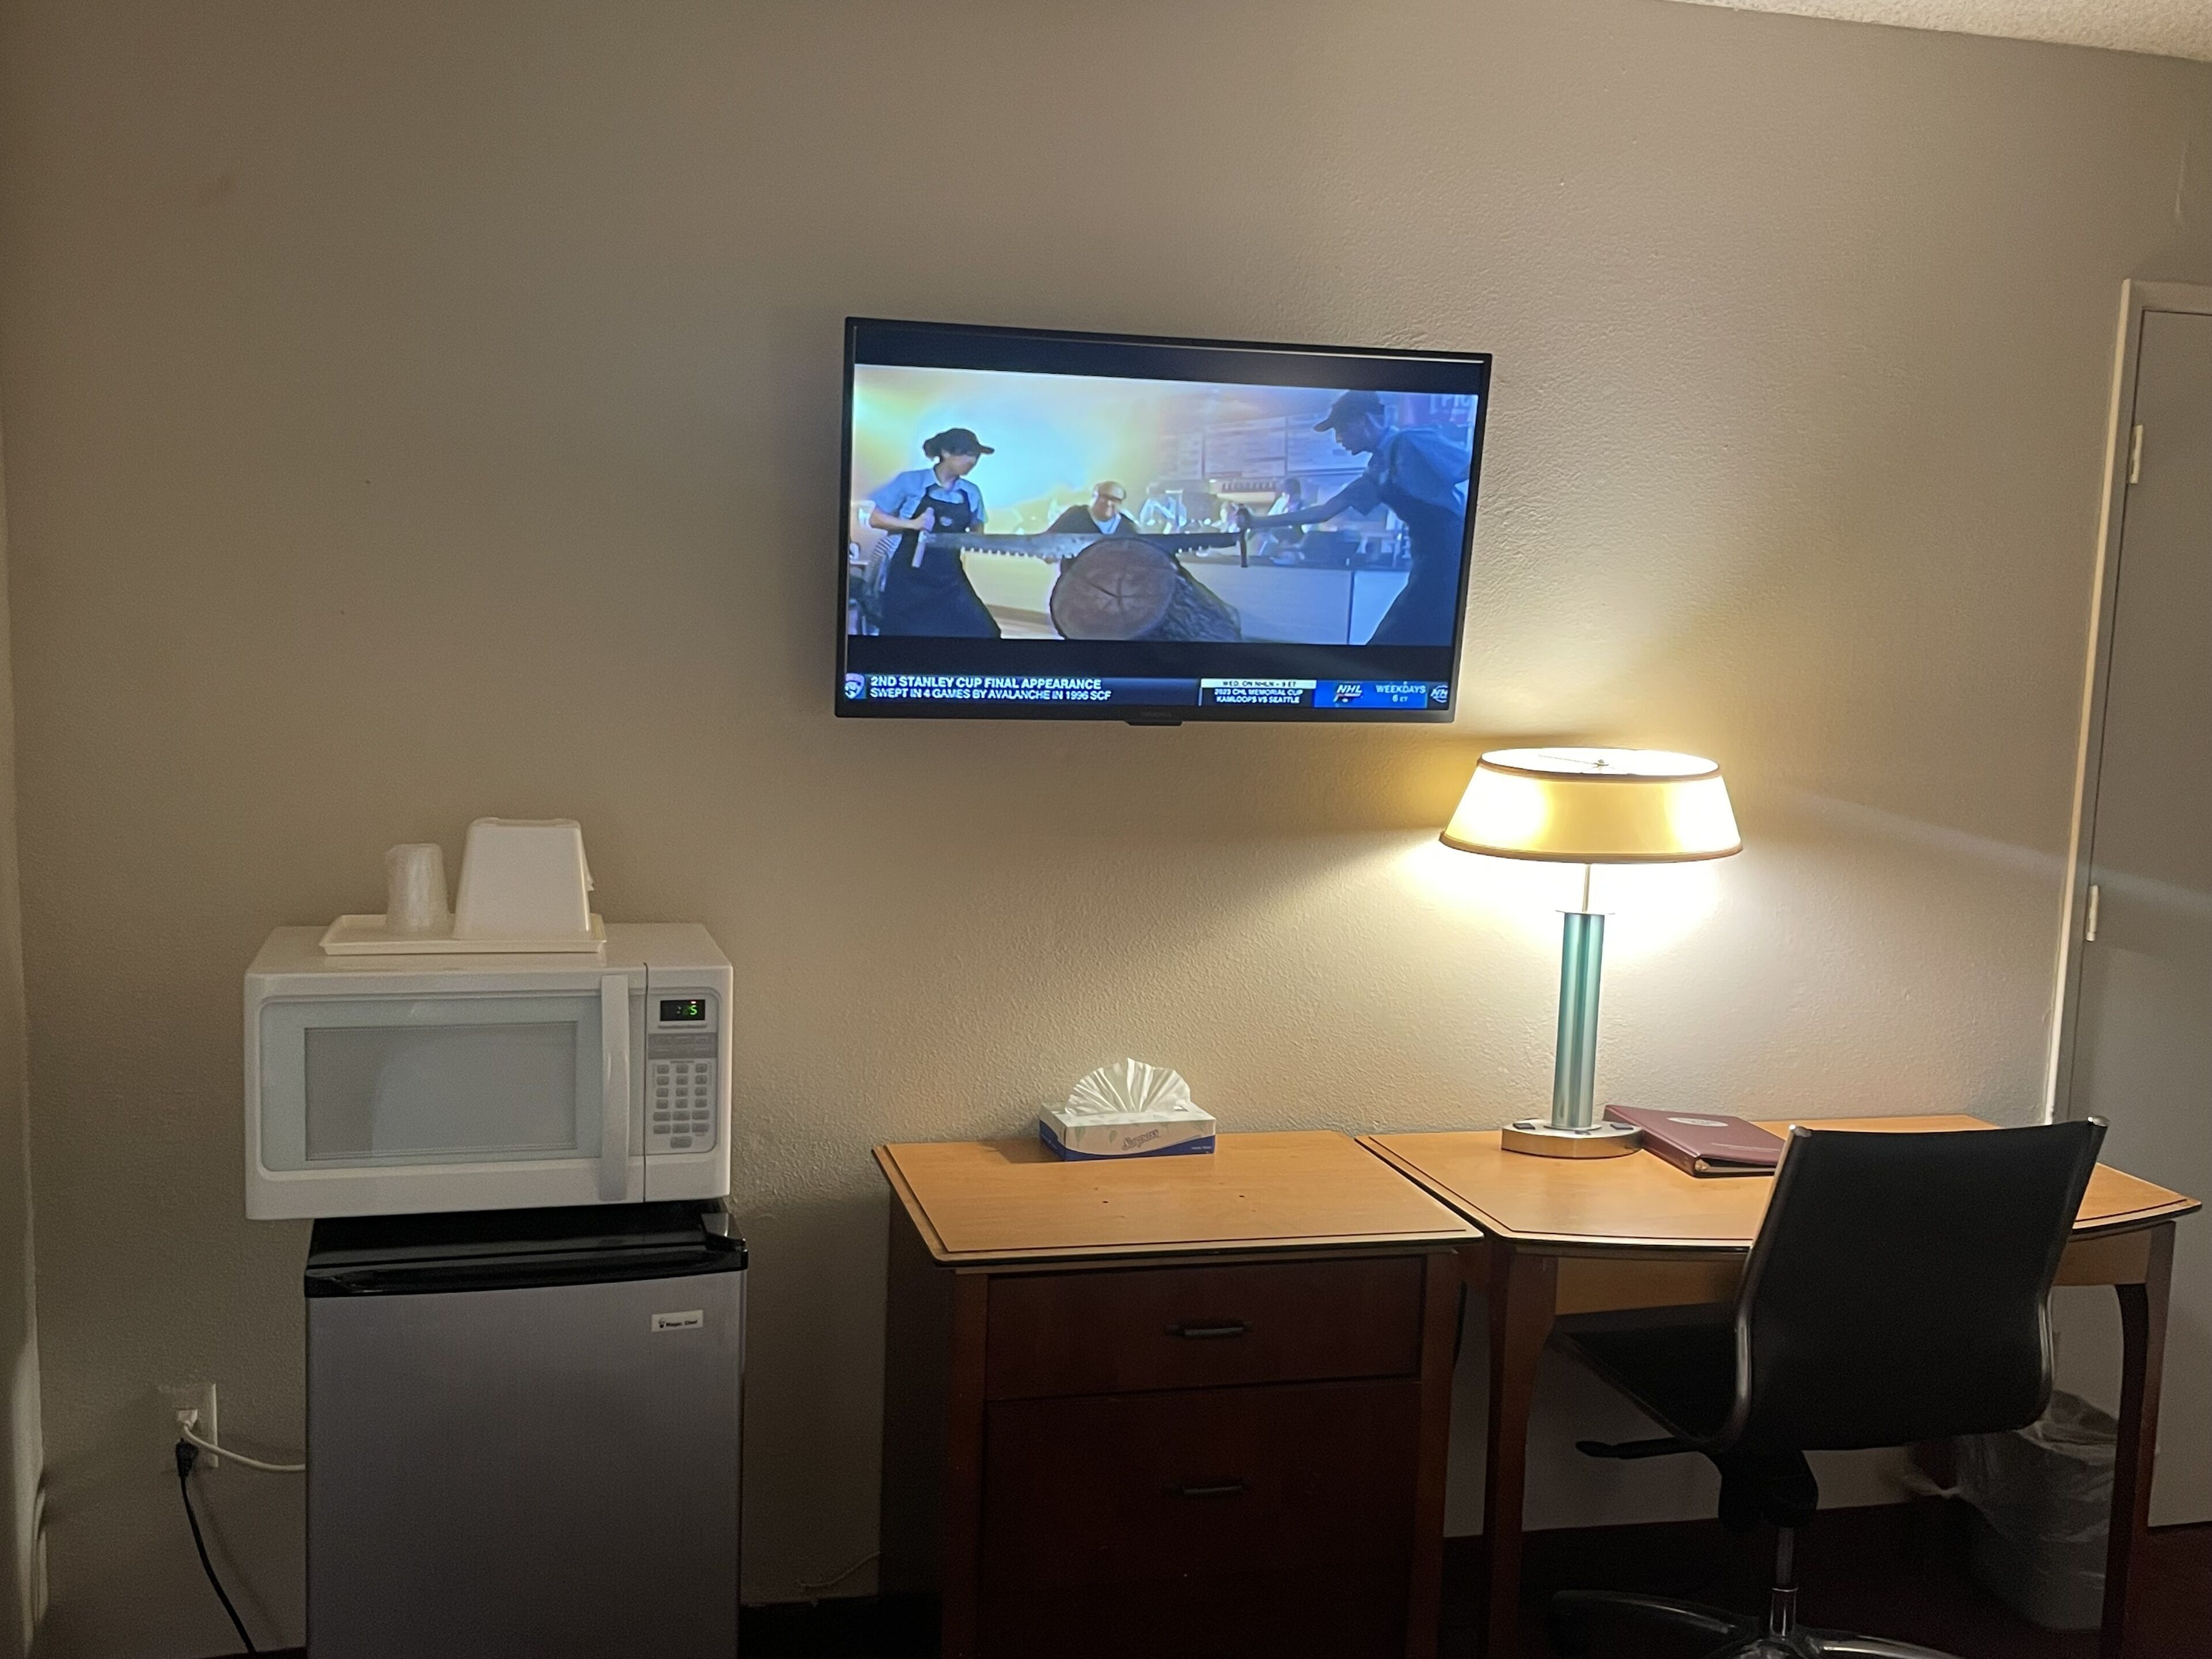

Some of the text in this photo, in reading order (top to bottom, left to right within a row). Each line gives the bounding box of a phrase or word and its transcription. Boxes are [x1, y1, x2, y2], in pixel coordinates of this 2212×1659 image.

[870, 676, 1101, 689] 2ND STANLEY CUP FINAL APPEARANCE
[870, 688, 908, 698] SWEPT
[910, 688, 922, 698] IN
[923, 689, 931, 698] 4
[932, 689, 971, 699] GAMES
[972, 689, 987, 699] BY
[987, 690, 1050, 699] AVALANCHE
[1052, 690, 1063, 699] IN
[1090, 691, 1112, 700] SCF
[1336, 685, 1362, 694] NHL
[1376, 685, 1426, 694] WEEKDAYS
